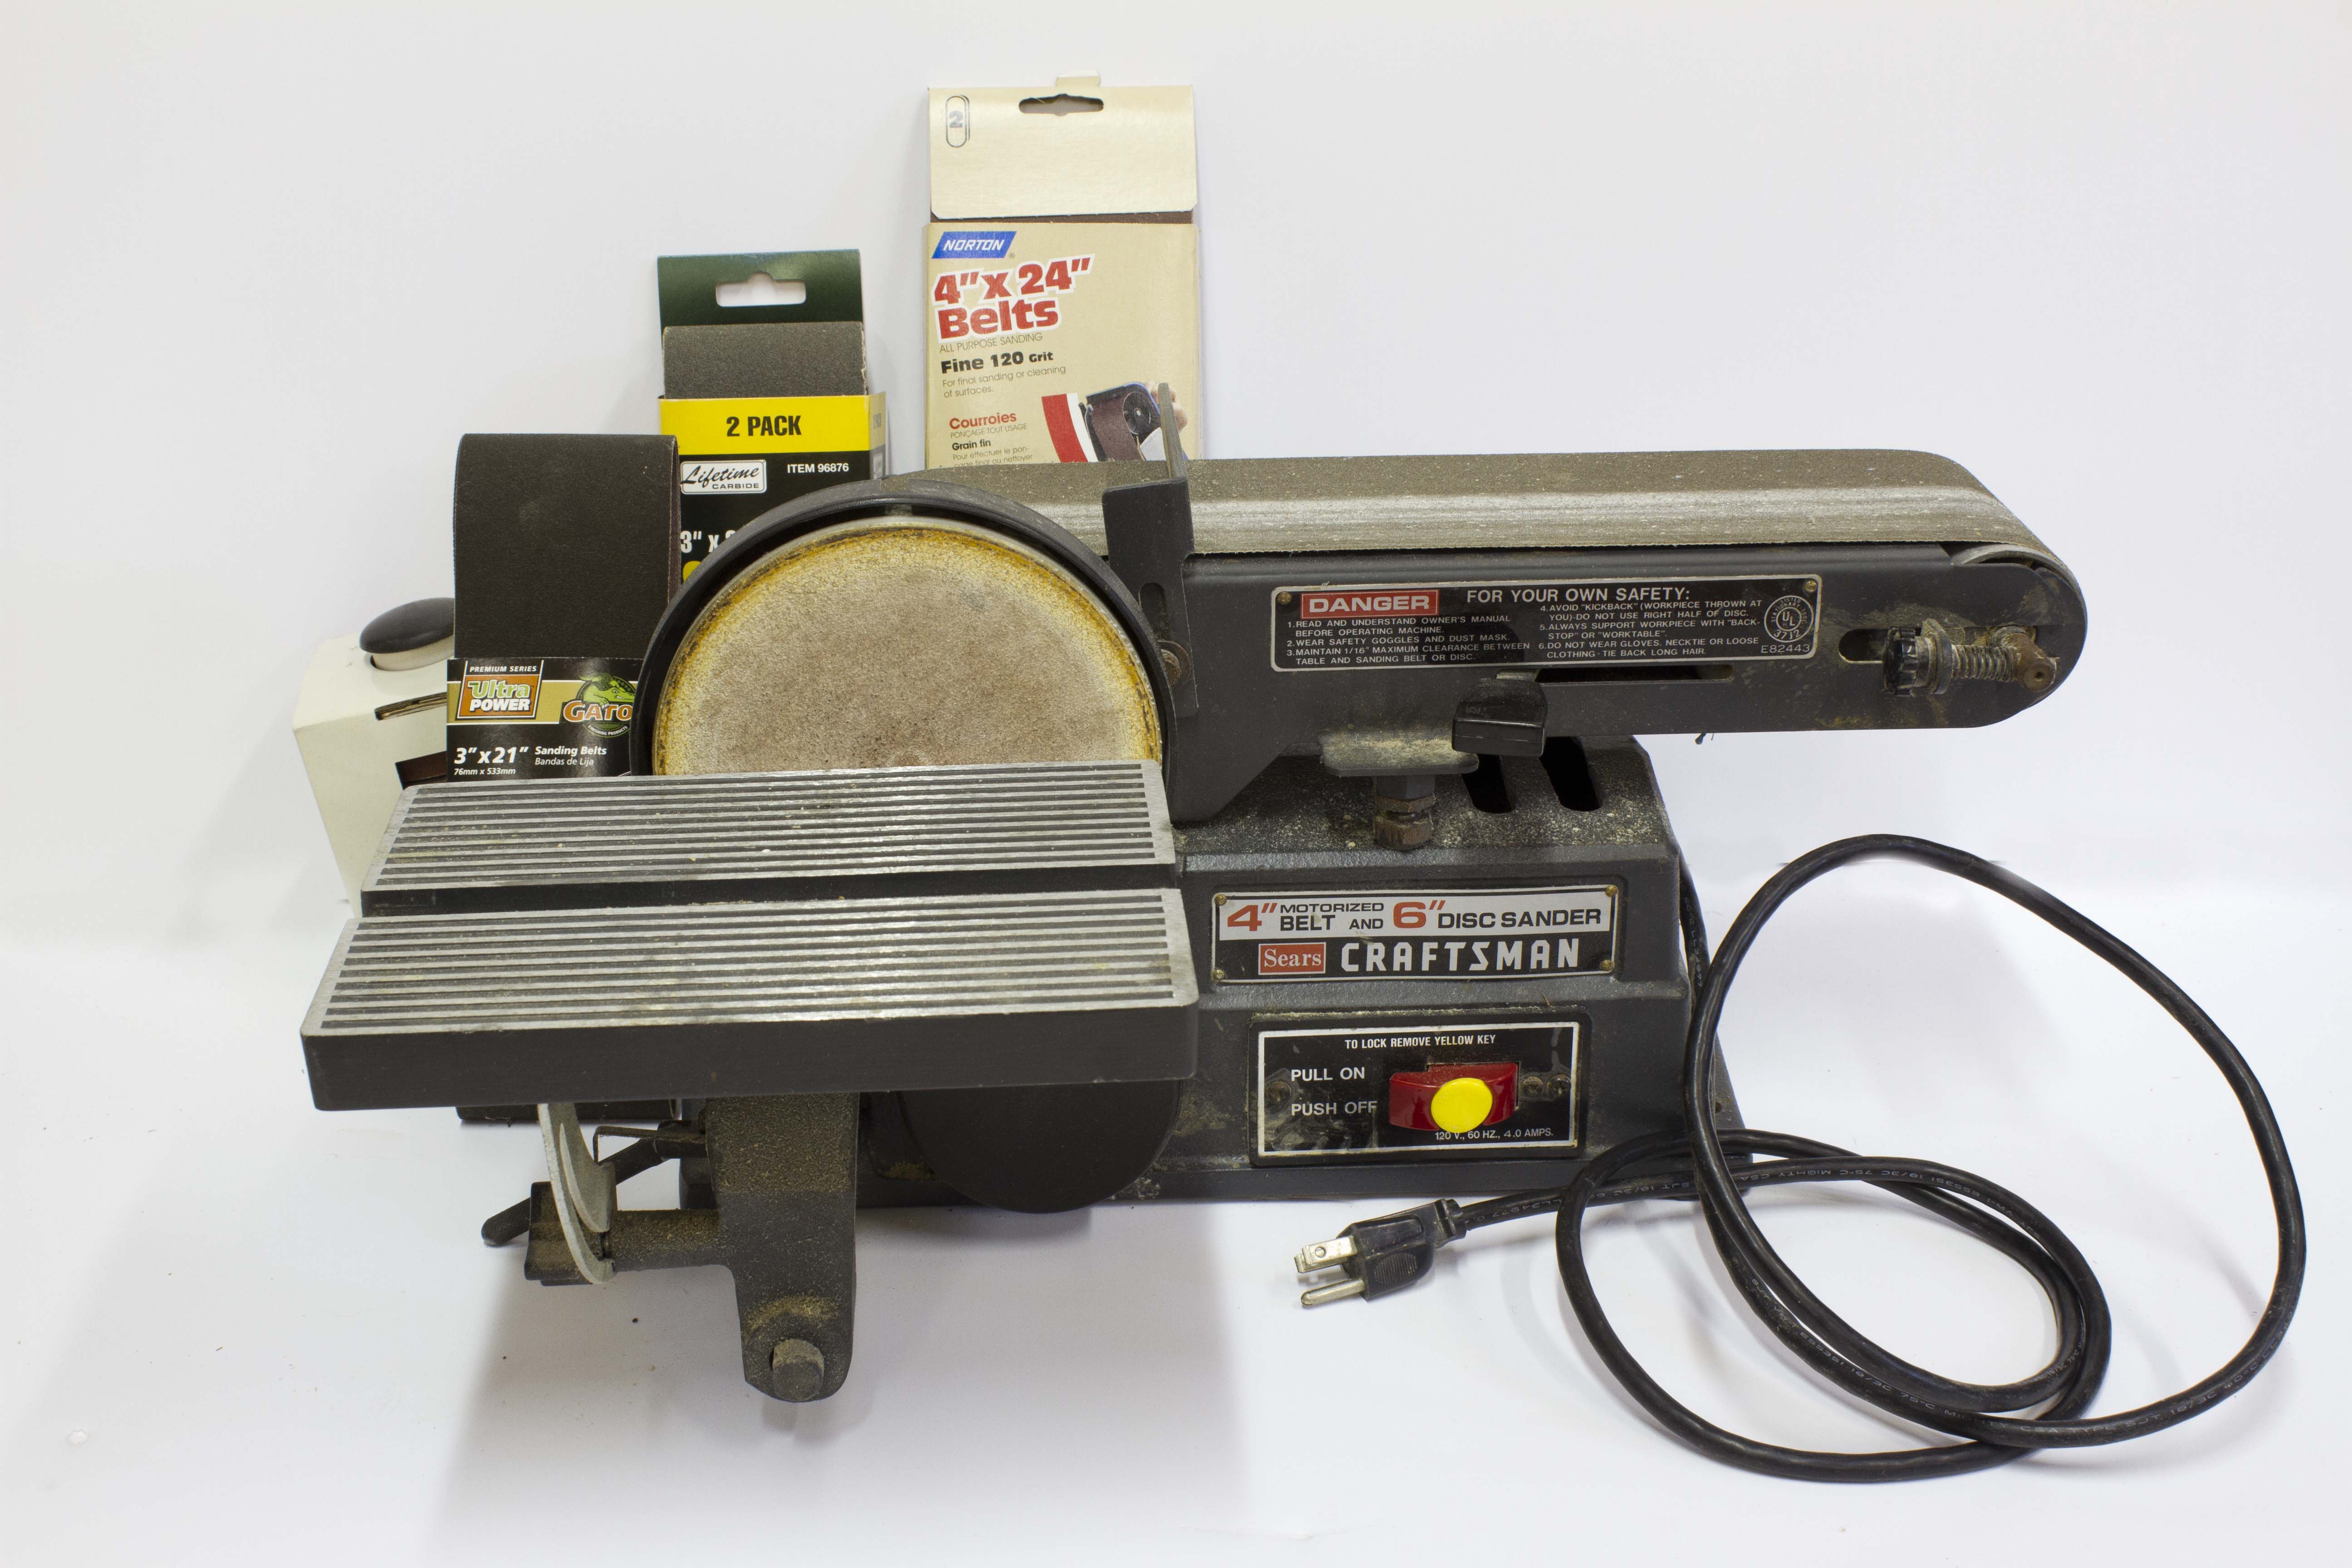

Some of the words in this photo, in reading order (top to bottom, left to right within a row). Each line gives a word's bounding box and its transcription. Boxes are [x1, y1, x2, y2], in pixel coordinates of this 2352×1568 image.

[949, 111, 962, 128] 2
[944, 239, 1004, 250] NORTON
[937, 299, 1058, 340] Belts
[940, 343, 955, 353] ALL
[957, 338, 997, 351] PURPOSE
[1000, 332, 1043, 349] SANDING
[941, 358, 984, 374] Fine
[990, 351, 1024, 368] 120
[1029, 352, 1053, 363] Grit
[943, 379, 955, 387] For
[958, 374, 976, 385] final
[979, 371, 1014, 384] sanding
[1027, 365, 1066, 378] cleaning
[944, 389, 953, 398] of
[955, 386, 993, 397] surfaces.
[726, 416, 740, 436] 2
[748, 416, 801, 436] PACK
[949, 412, 1017, 430] Courroies
[951, 428, 985, 439] PONÇAGE
[986, 426, 1004, 435] TOUT
[1005, 422, 1027, 431] USAGE
[952, 441, 977, 451] Grain
[980, 439, 991, 448] fin
[970, 450, 1001, 458] effectuer
[787, 464, 815, 474] ITEM
[818, 463, 849, 473] 96876
[681, 466, 759, 488] Lifetime
[681, 531, 701, 553] 3"
[1466, 589, 1503, 603] FOR
[1511, 588, 1558, 602] YOUR
[1566, 588, 1608, 601] OWN
[1616, 587, 1690, 600] SAFETY:
[1309, 595, 1430, 612] DANGER
[1581, 603, 1638, 611] "KICKBACK"
[1640, 601, 1700, 611] (WORKPIECE
[1705, 600, 1745, 608] THROWN
[1596, 612, 1615, 620] NOT
[1620, 611, 1638, 619] USE
[1645, 610, 1671, 619] RIGHT
[1725, 609, 1749, 617] DISC.
[1783, 611, 1795, 626] UL
[1592, 621, 1635, 630] SUPPORT
[1640, 619, 1695, 628] WORKPIECE
[1728, 618, 1760, 626] "BACK-
[1339, 627, 1393, 636] OPERATING
[1548, 632, 1578, 640] STOP"
[1344, 647, 1369, 655] 1/16"
[1372, 646, 1419, 654] MAXIMUM
[1424, 643, 1480, 652] CLEARANCE
[1484, 642, 1530, 651] BETWEEN
[1620, 639, 1661, 647] GLOVES.
[1666, 637, 1705, 646] NECKTIE
[1621, 648, 1646, 657] BACK
[1651, 648, 1677, 656] LONG
[1682, 647, 1706, 655] HAIR.
[1761, 644, 1810, 654] E82443
[467, 679, 531, 699] Ultra
[469, 698, 530, 712] POWER
[608, 726, 628, 735] PRODUCTS
[535, 746, 578, 757] Sanding
[581, 746, 607, 755] Belts
[579, 757, 594, 766] Lija
[1280, 902, 1385, 914] MOTORIZED
[1227, 903, 1277, 932] 4"
[1280, 915, 1336, 931] BELT
[1349, 918, 1384, 930] AND
[1393, 900, 1446, 929] 6"
[1438, 912, 1497, 929] DISC
[1500, 908, 1602, 927] SANDER
[1264, 948, 1322, 968] Sears
[1341, 938, 1579, 972] CRAFTSMAN
[1345, 1039, 1357, 1049] TO
[1362, 1039, 1387, 1049] LOCK
[1391, 1036, 1431, 1047] REMOVE
[1435, 1035, 1474, 1046] YELLOW
[1477, 1034, 1496, 1044] KEY
[1291, 1068, 1333, 1082] PULL
[1340, 1067, 1365, 1079] ON
[1291, 1102, 1337, 1116] PUSH
[1344, 1101, 1378, 1113] OFF
[1435, 1131, 1452, 1140] 120
[1468, 1130, 1480, 1139] 60
[1483, 1129, 1500, 1140] HZ.,
[1504, 1129, 1522, 1138] 4.0
[1524, 1127, 1553, 1138] AMPS.
[1740, 1173, 1770, 1181] CSA
